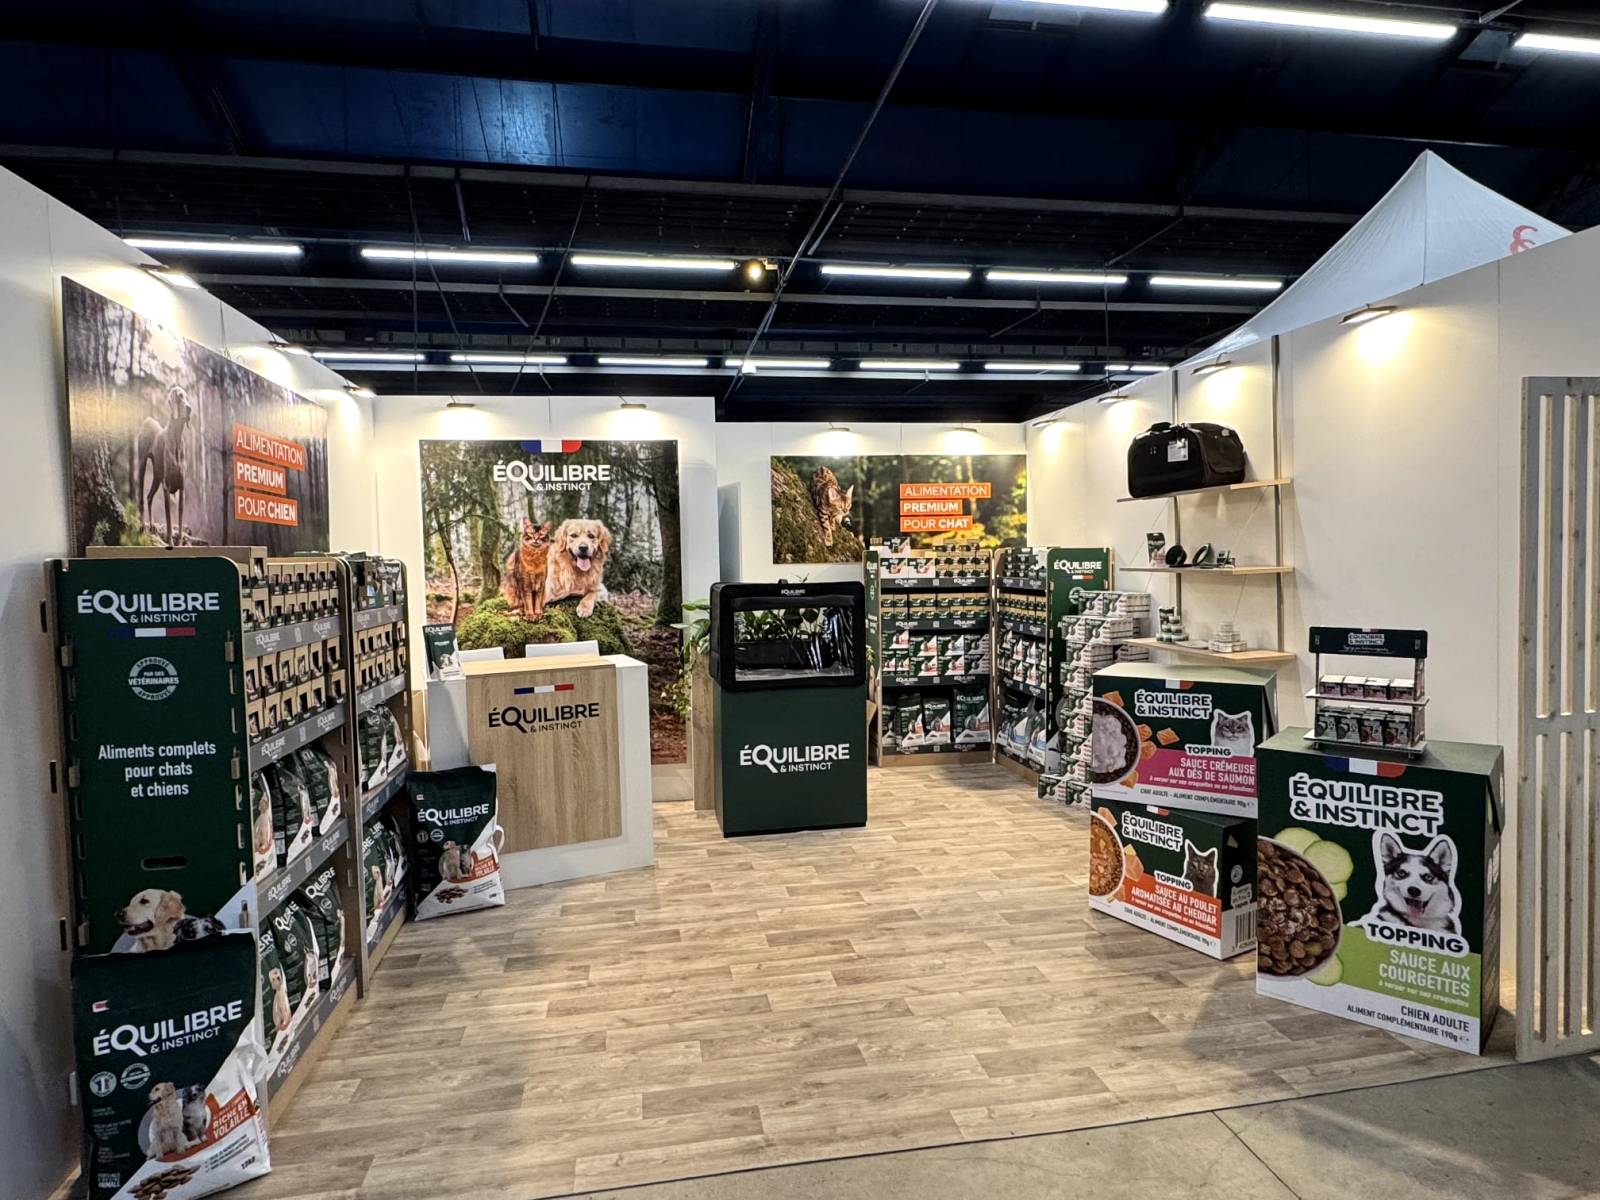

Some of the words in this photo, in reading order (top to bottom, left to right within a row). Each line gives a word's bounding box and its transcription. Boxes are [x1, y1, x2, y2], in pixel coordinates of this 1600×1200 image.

[236, 429, 303, 465] ALIMENTATION
[236, 462, 284, 488] PREMIUM
[493, 460, 610, 491] ÉQUILIBRE
[536, 483, 544, 491] &
[545, 482, 592, 491] INSTINCT
[904, 486, 987, 496] ALIMENTATION
[237, 495, 266, 517] POUR
[267, 501, 296, 520] CHIEN
[903, 502, 958, 512] PREMIUM
[903, 519, 936, 528] POUR
[938, 518, 969, 528] CHAT
[1053, 559, 1102, 574] ÉQUILIBRE
[77, 589, 220, 624] ÉQUILIBRE
[129, 614, 139, 623] &
[140, 612, 198, 623] INSTINCT
[128, 675, 179, 686] VÉTÉRINAIRES
[1136, 690, 1211, 706] ÉQUILIBRE
[488, 702, 600, 734] ÉQUILIBRE
[1136, 705, 1146, 715] &
[1147, 706, 1210, 718] INSTINCT
[530, 725, 537, 733] &
[538, 720, 582, 732] INSTINCT
[98, 744, 155, 760] Aliments
[158, 740, 217, 759] complets
[739, 743, 850, 773] ÉQUILIBRE
[1186, 746, 1231, 756] TOPPING
[125, 766, 155, 782] pour
[158, 761, 193, 776] chats
[780, 765, 787, 773] &
[788, 762, 832, 772] INSTINCT
[1168, 767, 1185, 778] AUX
[1187, 769, 1202, 780] DÉS
[1205, 771, 1217, 781] DE
[1218, 773, 1255, 786] SAUMON
[1180, 758, 1208, 769] SAUCE
[1209, 760, 1256, 774] CRÉMEUSE
[130, 783, 144, 798] et
[147, 781, 190, 797] chiens
[1293, 776, 1439, 813] ÉQUILIBRE
[417, 803, 490, 826] ÉQUILIBRE
[1123, 813, 1182, 839] ÉQUILIBRE
[1294, 801, 1312, 818] &
[1315, 802, 1439, 834] INSTINCT
[1123, 826, 1131, 837] &
[1132, 828, 1181, 850] INSTINCT
[1156, 872, 1192, 889] TOPPING
[1131, 886, 1172, 909] AROMATISÉE
[1172, 900, 1182, 913] AU
[1183, 905, 1217, 925] CHEDDAR
[1155, 884, 1177, 901] SAUCE
[1178, 891, 1188, 904] AU
[1189, 896, 1217, 915] POULET
[1368, 923, 1464, 953] TOPPING
[1390, 949, 1437, 973] SAUCE
[1441, 961, 1471, 981] AUX
[1379, 963, 1470, 997] COURGETTES
[92, 1000, 243, 1057] ÉQUILIBRE
[1347, 1004, 1375, 1018] ALIMENT
[1377, 1012, 1439, 1036] COMPLÉMENTAIRE
[1440, 1029, 1458, 1043] 190g
[1401, 1005, 1430, 1022] CHIEN
[1432, 1013, 1470, 1033] ADULTE
[150, 1044, 160, 1054] &
[161, 1026, 221, 1051] INSTINCT
[212, 1108, 237, 1129] RICHE
[213, 1106, 251, 1140] VOLAILLE
